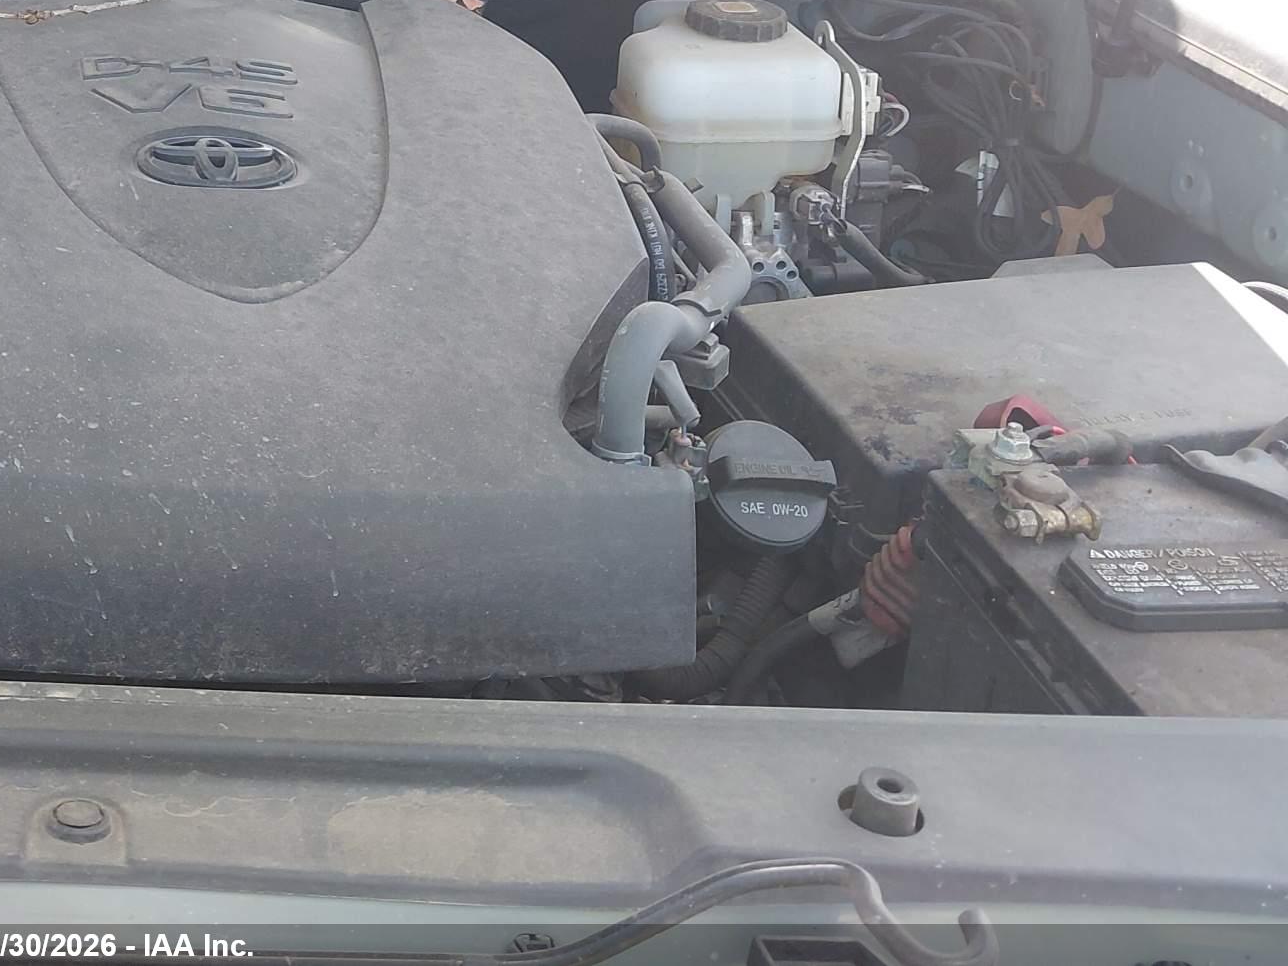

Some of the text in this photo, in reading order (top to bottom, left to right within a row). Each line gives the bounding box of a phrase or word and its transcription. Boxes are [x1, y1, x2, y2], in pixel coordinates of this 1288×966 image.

[734, 462, 796, 476] ENGINE OIL
[741, 502, 809, 518] SAE 0W-20
[1103, 549, 1157, 559] DANGER
[1165, 547, 1215, 557] POISON
